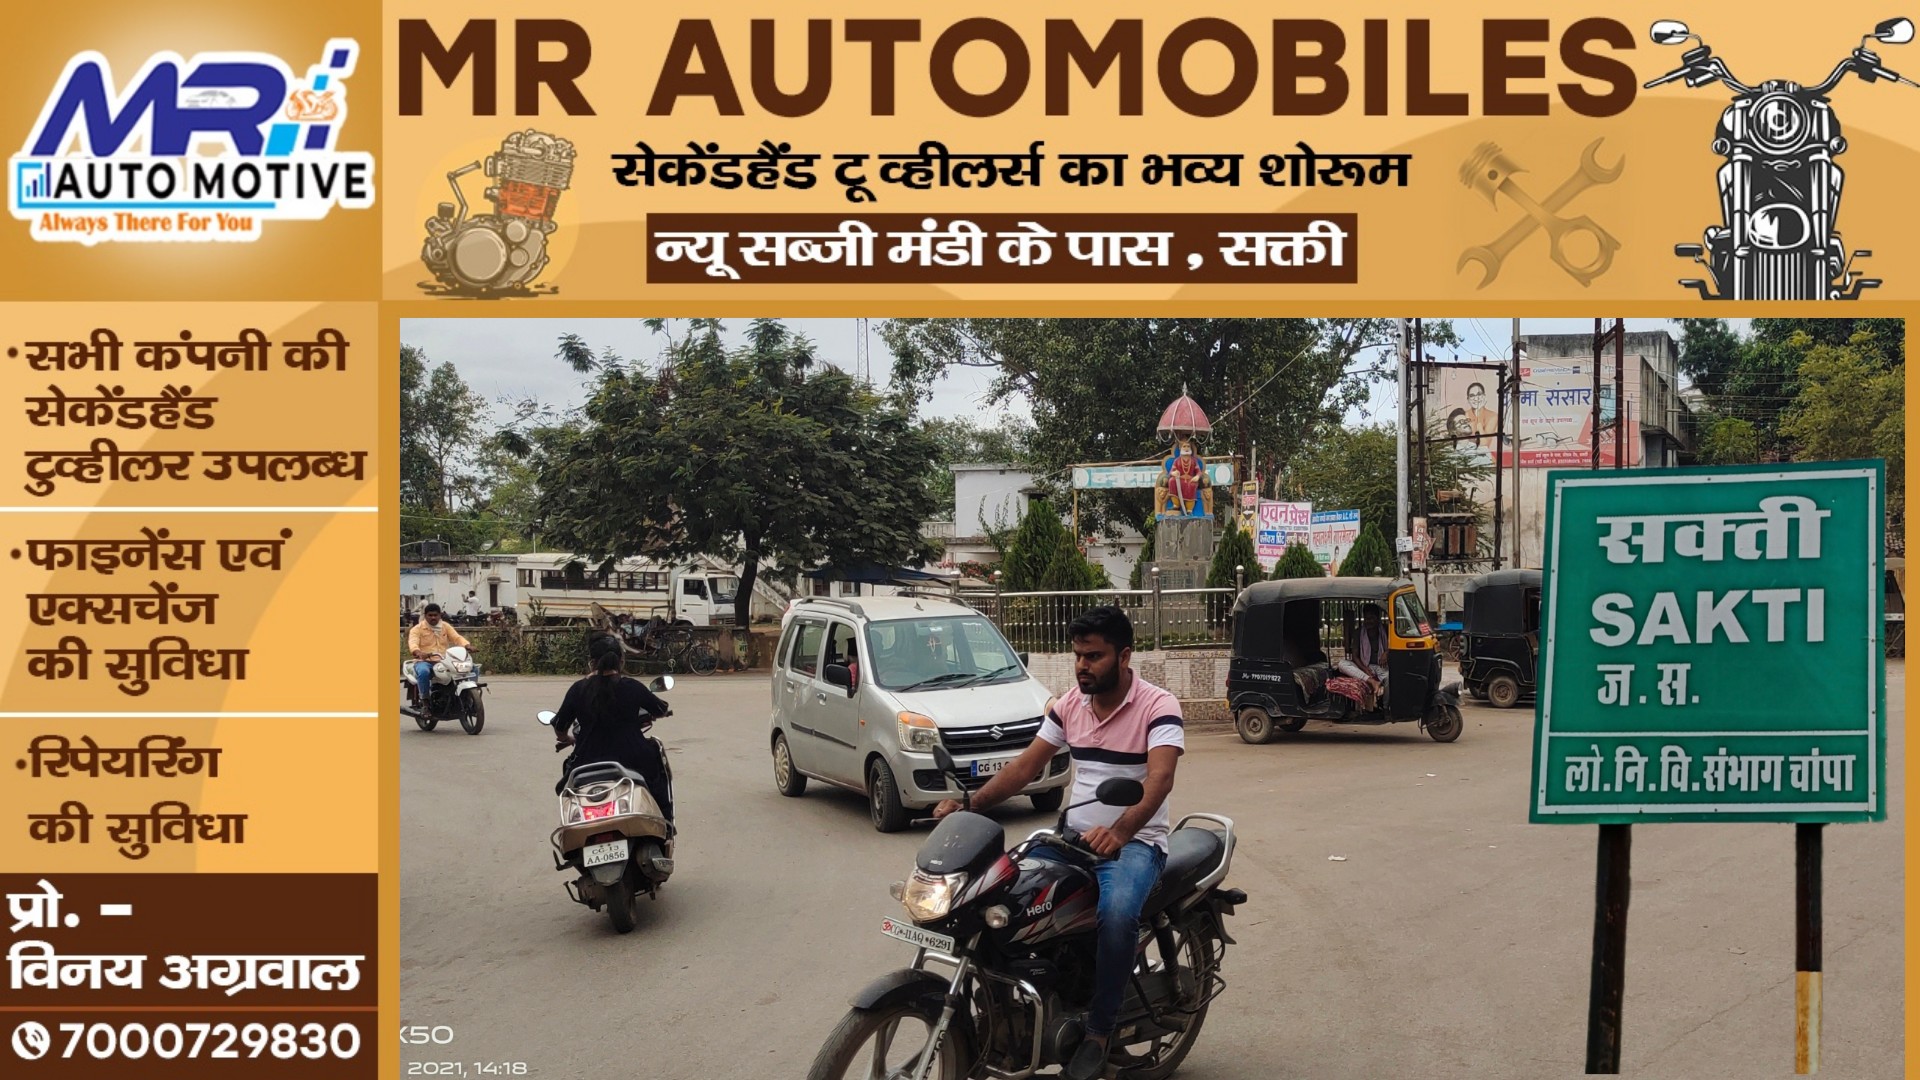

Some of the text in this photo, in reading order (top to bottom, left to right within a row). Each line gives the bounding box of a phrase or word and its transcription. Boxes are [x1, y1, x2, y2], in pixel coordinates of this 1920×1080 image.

[1546, 382, 1591, 406] संसार
[1260, 504, 1309, 529] एवन प्रेस
[1597, 496, 1831, 563] सक्ती
[1589, 588, 1824, 647] SAKTI
[978, 762, 1002, 772] CG 13
[1789, 748, 1856, 790] चांपा
[587, 851, 625, 865] AA-0856
[1026, 901, 1052, 916] Hero
